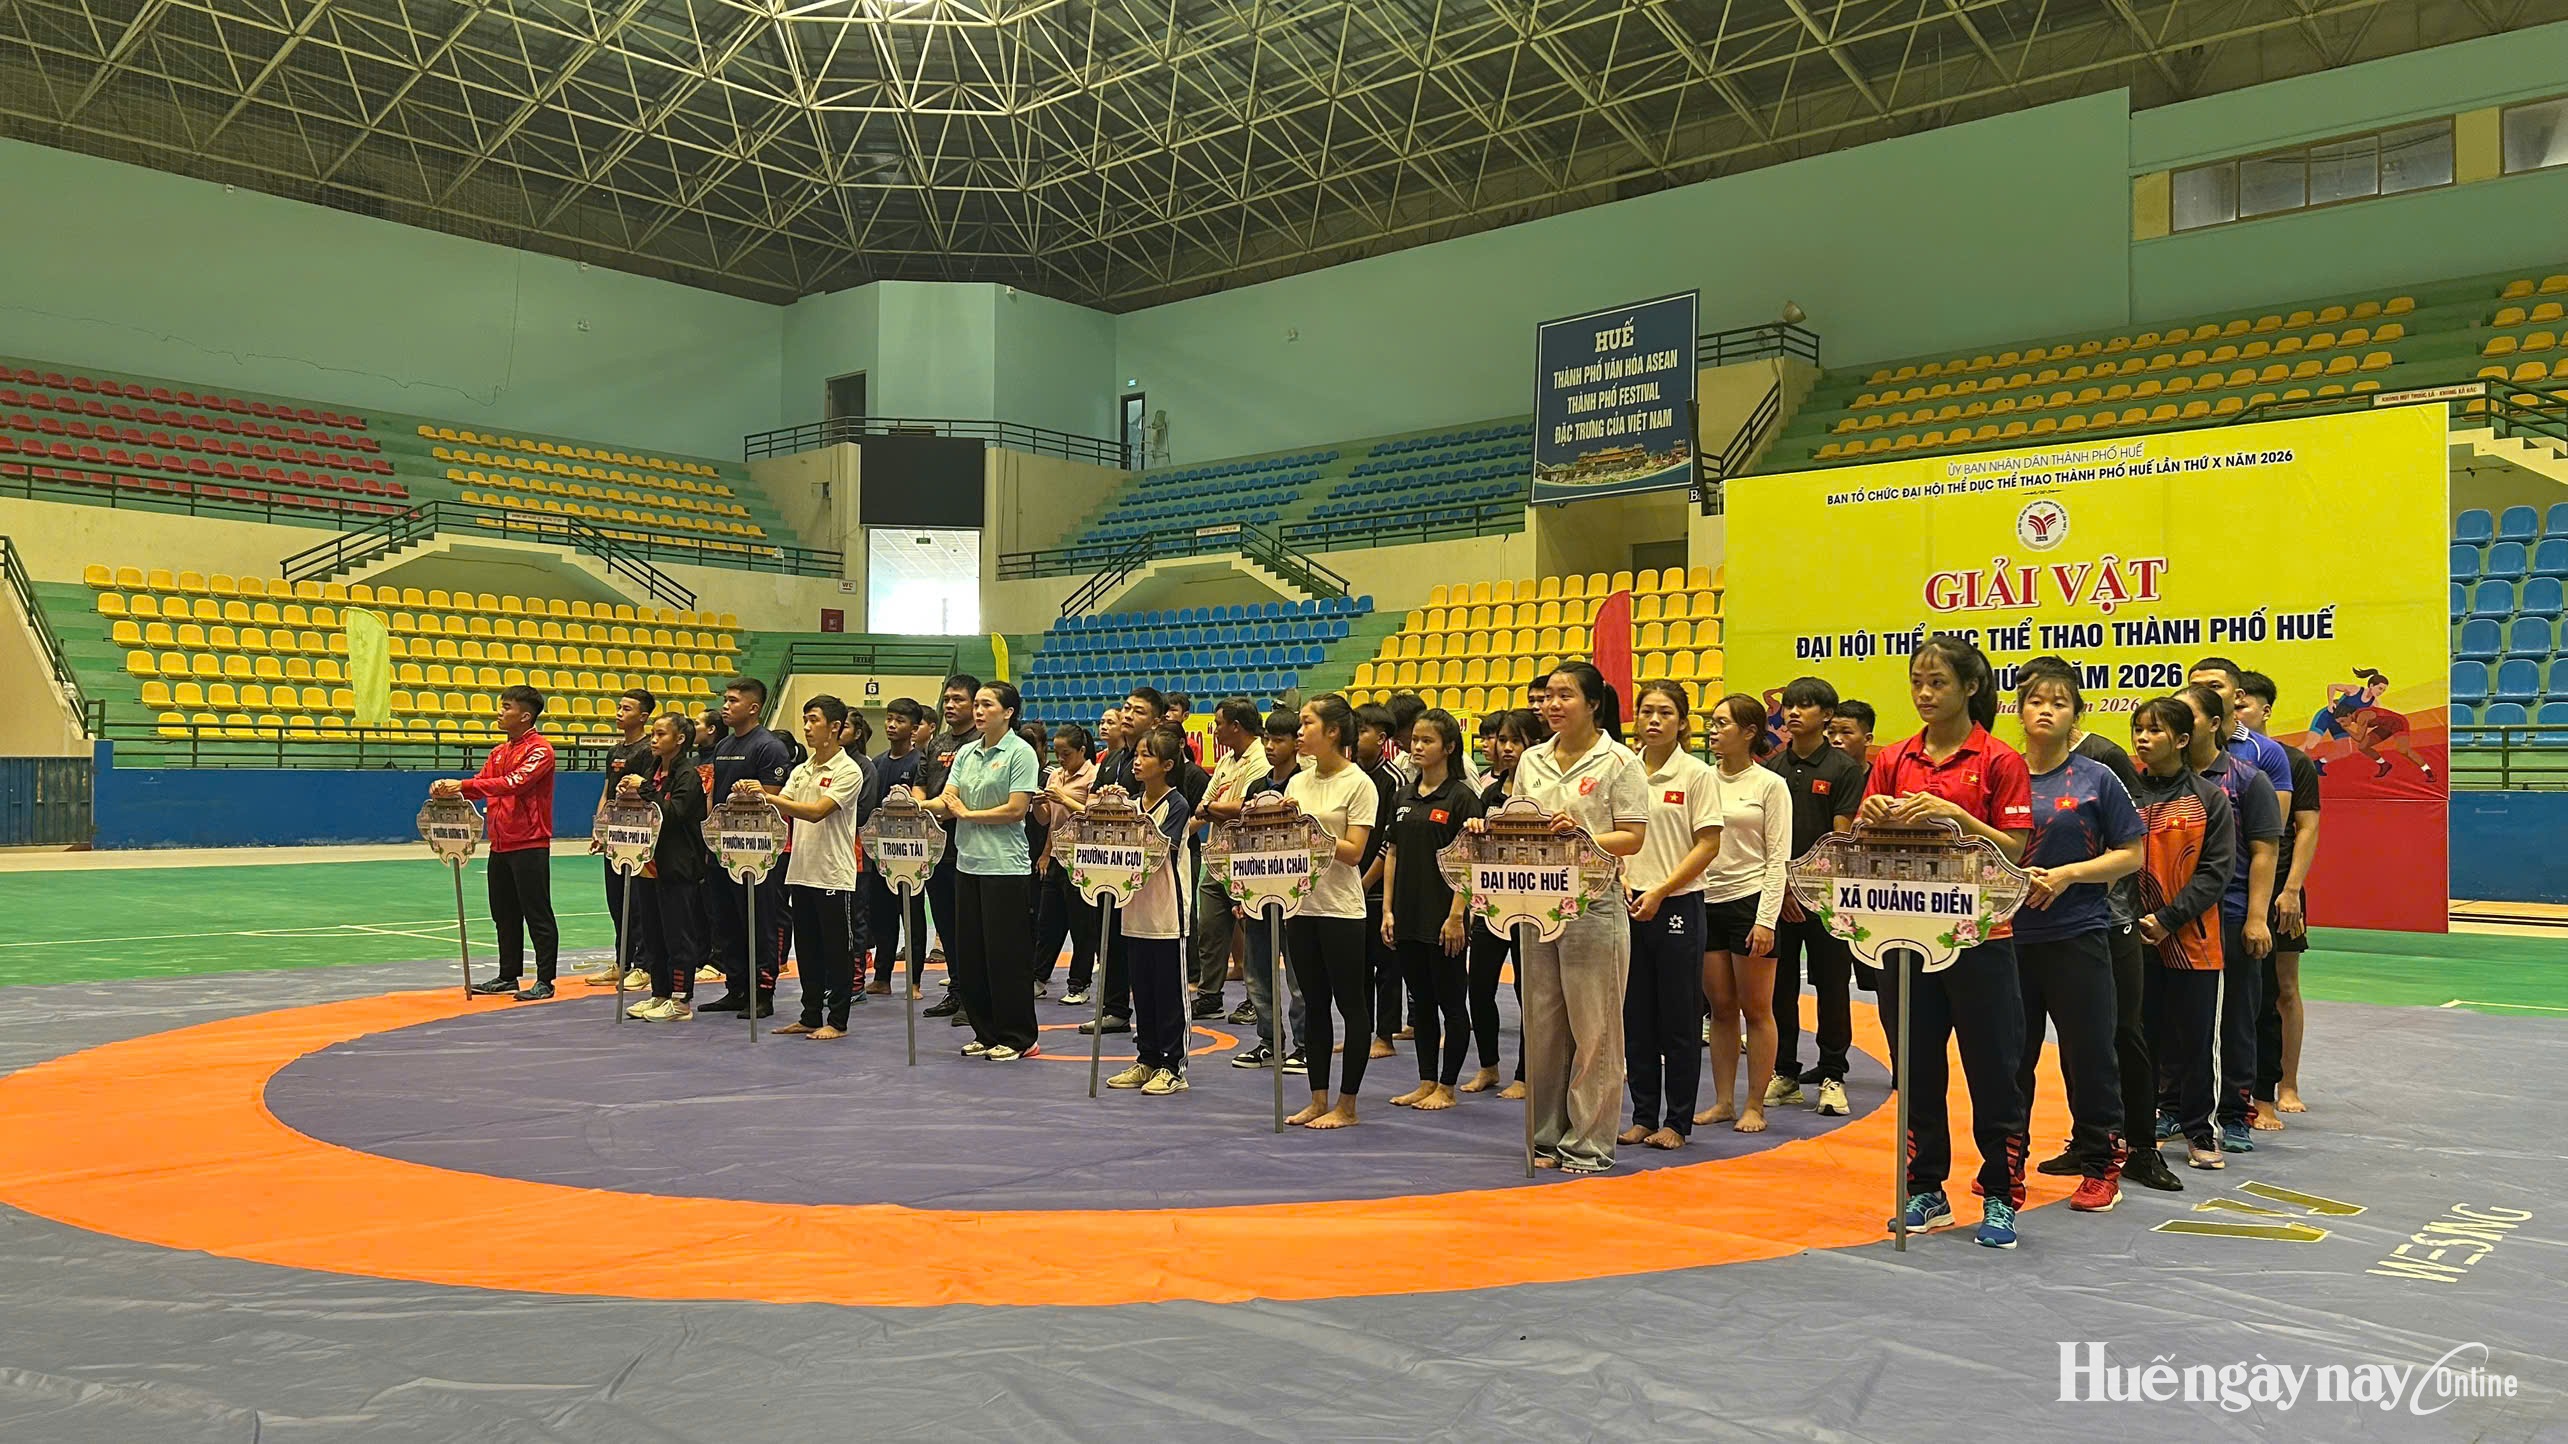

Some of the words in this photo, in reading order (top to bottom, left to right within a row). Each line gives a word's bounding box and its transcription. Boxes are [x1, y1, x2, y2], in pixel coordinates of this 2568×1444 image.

[1595, 317, 1635, 352] HUẾ
[1553, 366, 1582, 389] THÀNH
[1584, 358, 1602, 383] PHỐ
[1604, 358, 1623, 380] VĂN
[1625, 356, 1644, 376] HÓA
[1646, 349, 1678, 372] ASEAN
[1567, 391, 1596, 414] THÀNH
[1598, 382, 1618, 409] PHỐ
[1619, 381, 1660, 406] FESTIVAL
[1554, 421, 1573, 446] ĐẶC
[1575, 418, 1604, 441] TRƯNG
[1606, 410, 1625, 436] CỦA
[1627, 409, 1648, 436] VIỆT
[1649, 408, 1672, 430] NAM
[1948, 461, 1962, 476] ỦY
[1964, 460, 1986, 474] BAN
[1989, 456, 2021, 472] NHÂN
[2023, 454, 2049, 469] DÂN
[2051, 448, 2088, 467] THÀNH
[2092, 445, 2117, 460] PHỐ
[2120, 442, 2144, 458] HUẾ
[1827, 493, 1848, 505] BAN
[1851, 487, 1865, 502] TỔ
[1868, 487, 1899, 501] CHỨC
[1902, 487, 1921, 500] ĐẠI
[1924, 482, 1944, 498] HỘI
[1948, 477, 1968, 493] THỂ
[1970, 479, 1994, 493] DỤC
[1997, 472, 2018, 489] THỂ
[2020, 473, 2051, 486] THAO
[2055, 466, 2095, 483] THÀNH
[2099, 462, 2125, 479] PHỐ
[2129, 459, 2155, 476] HUẾ
[2156, 457, 2180, 474] LẦN
[2184, 456, 2210, 472] THỨ
[2211, 457, 2222, 469] X
[2225, 452, 2256, 467] NĂM
[2260, 450, 2293, 464] 2026
[1924, 557, 2040, 612] GIẢI
[2050, 554, 2167, 614] VẬT
[1796, 635, 1832, 662] ĐẠI
[1840, 630, 1876, 661] HỘI
[1987, 617, 2033, 651] THỂ
[2039, 623, 2103, 650] THAO
[2112, 616, 2200, 647] THÀNH
[2210, 606, 2268, 643] PHỐ
[2276, 605, 2337, 640] HUẾ
[867, 683, 877, 693] 6
[2118, 663, 2183, 689] 2026
[2098, 697, 2140, 713] 2026
[608, 829, 627, 843] PHƯỜNG
[628, 829, 640, 844] PHÚ
[722, 834, 745, 850] PHƯỜNG
[745, 835, 757, 850] PHÚ
[757, 836, 772, 851] XUÂN
[882, 841, 908, 859] TRỌNG
[909, 841, 924, 857] TÀI
[1076, 846, 1109, 864] PHƯỜNG
[1110, 852, 1123, 865] AN
[1125, 852, 1142, 869] CỰU
[1233, 856, 1266, 876] PHƯỜNG
[1267, 855, 1284, 875] HÓA
[1286, 854, 1308, 874] CHÂU
[1480, 871, 1504, 893] ĐẠI
[1508, 872, 1536, 894] HỌC
[1540, 867, 1570, 892] HUẾ
[1839, 884, 1862, 909] XÃ
[1867, 883, 1926, 913] QUẢNG
[1931, 884, 1973, 915] ĐIỀN
